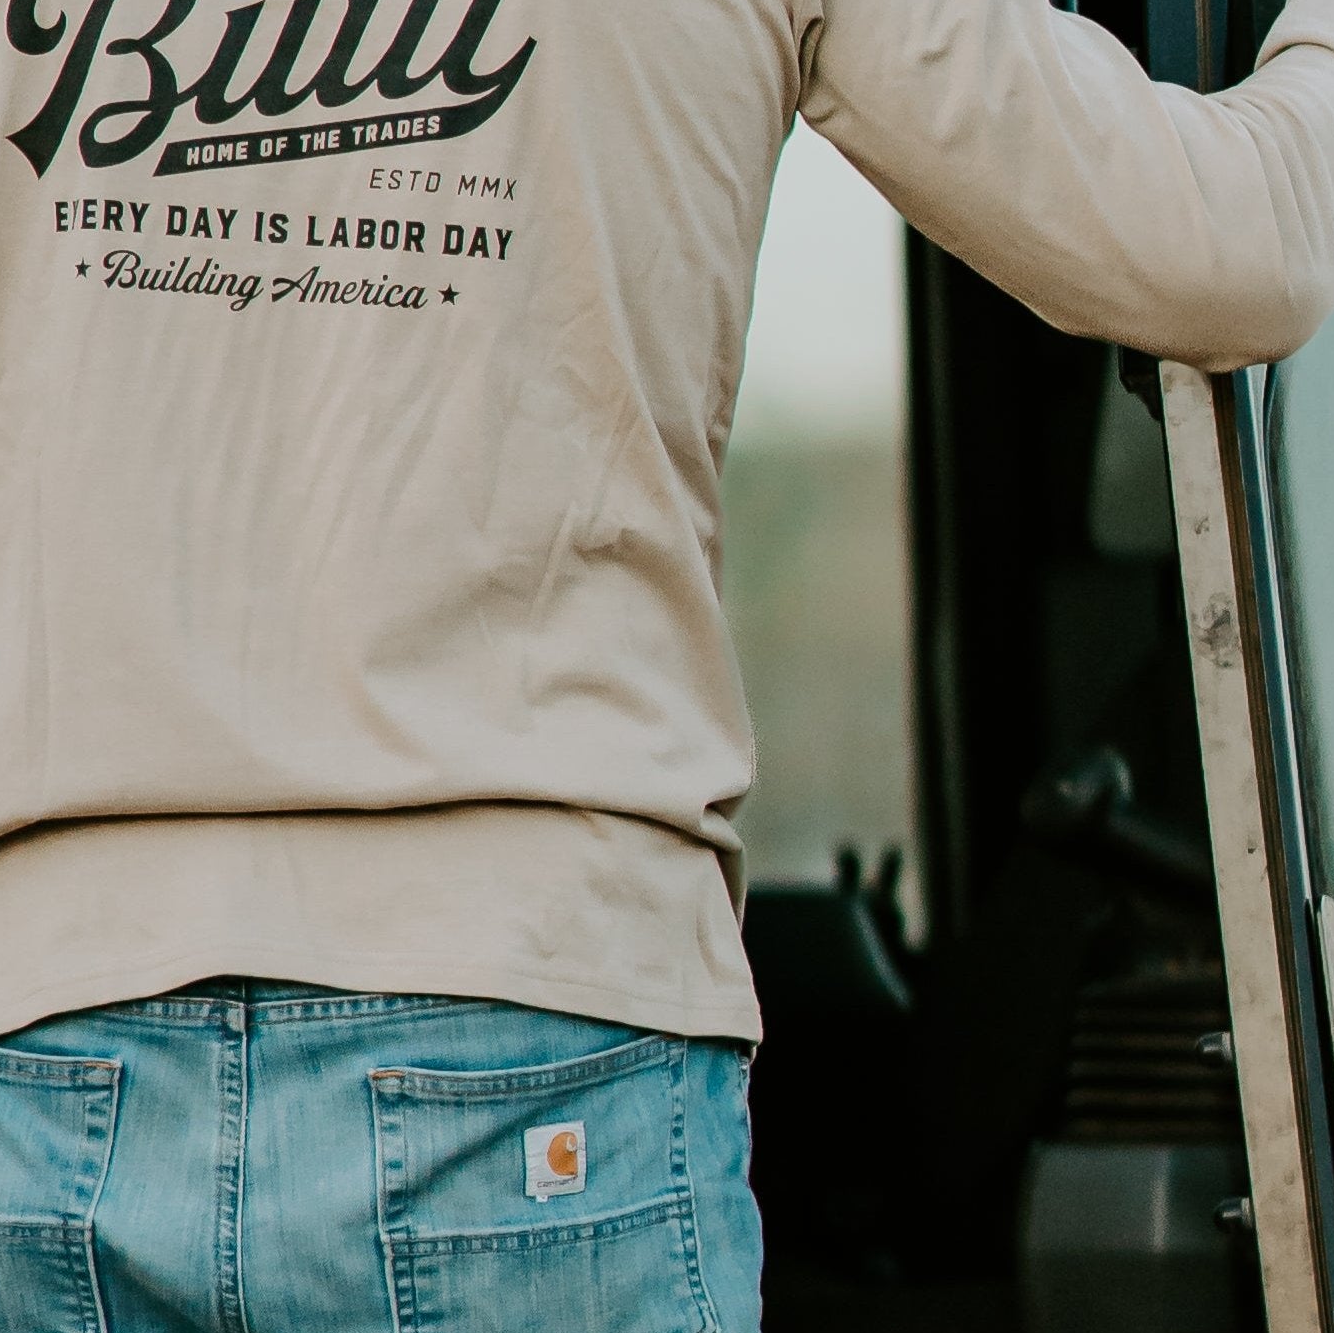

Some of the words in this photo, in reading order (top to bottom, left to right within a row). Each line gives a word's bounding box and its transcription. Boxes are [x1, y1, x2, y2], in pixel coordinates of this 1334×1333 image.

[186, 141, 248, 166] HOME
[259, 135, 288, 158] OF
[299, 128, 341, 154] THE
[353, 115, 442, 146] TRADES
[369, 168, 442, 193] ESTD
[457, 174, 518, 202] MMX
[166, 204, 239, 240] DAY
[254, 211, 289, 244] IS
[306, 216, 426, 254] LABOR
[442, 223, 514, 261] DAY
[103, 249, 265, 312] Building
[271, 265, 430, 310] America
